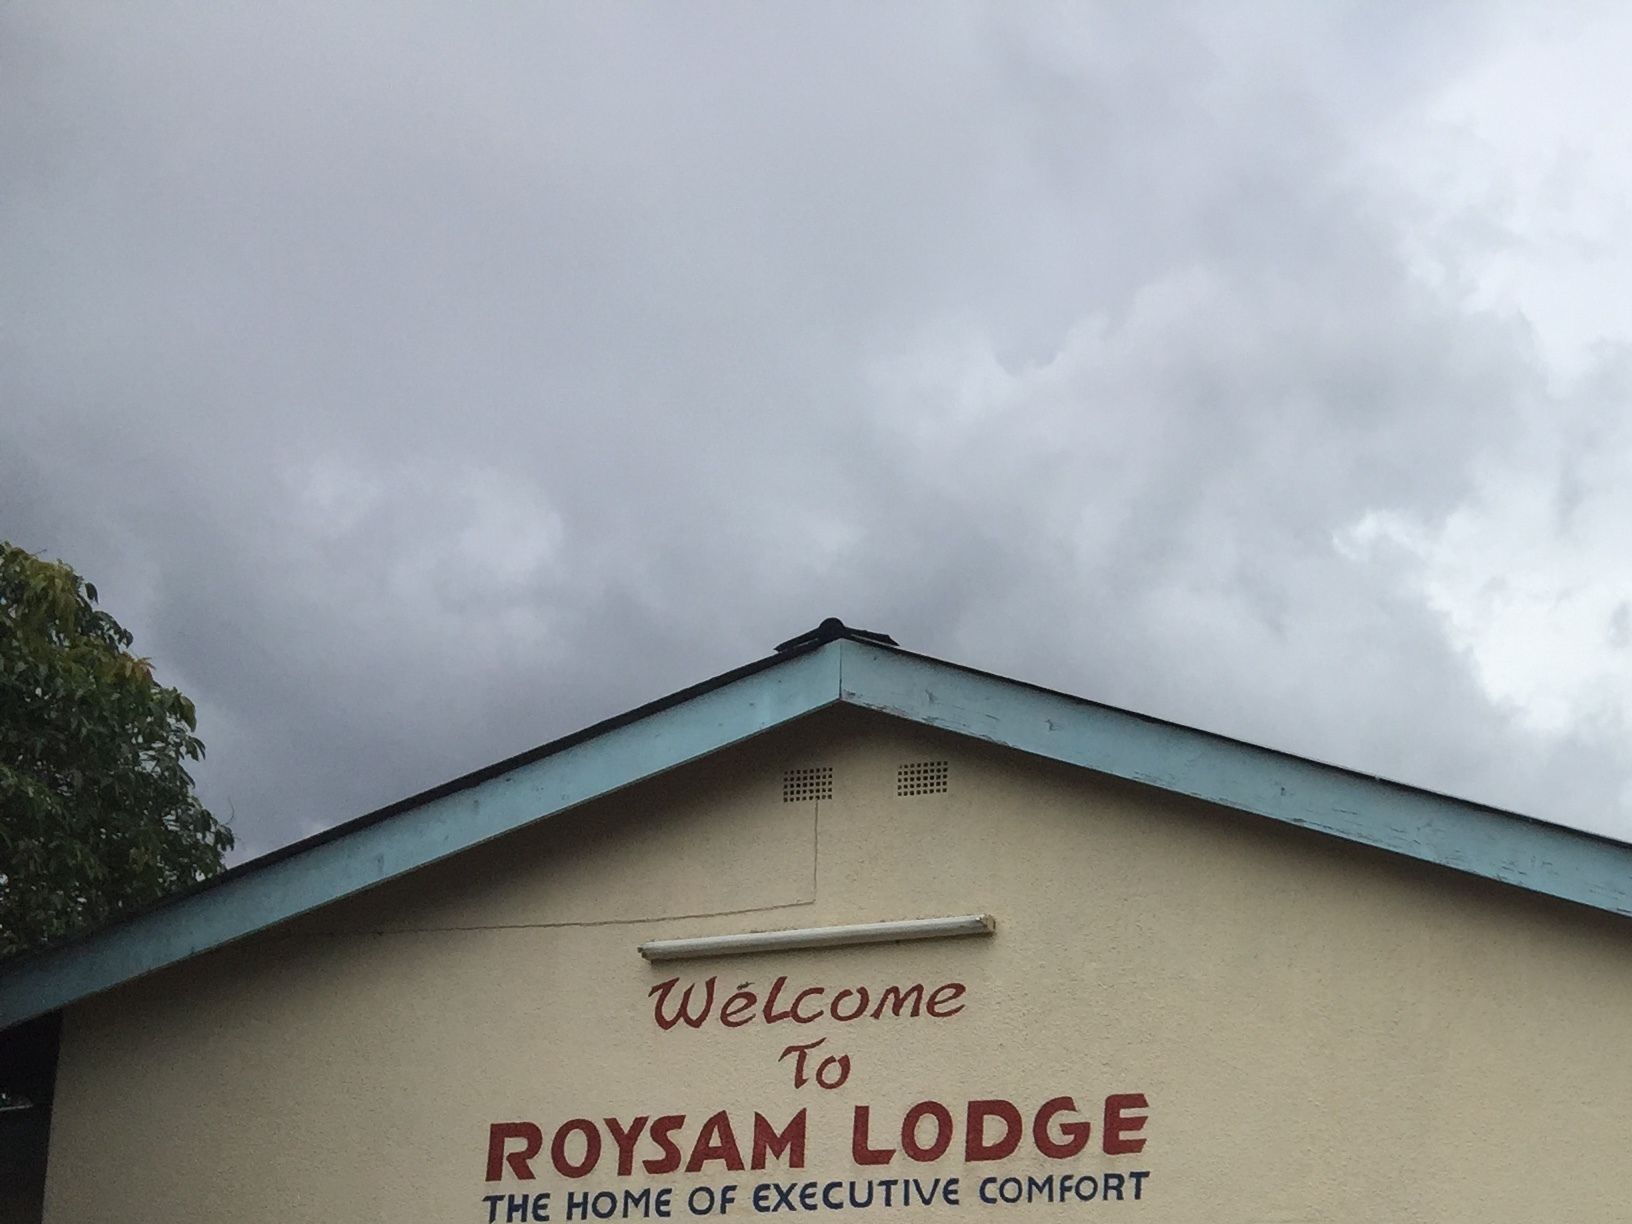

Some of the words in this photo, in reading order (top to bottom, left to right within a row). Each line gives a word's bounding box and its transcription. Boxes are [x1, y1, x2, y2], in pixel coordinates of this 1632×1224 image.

[778, 1037, 852, 1090] To
[485, 1107, 808, 1182] ROYSAM
[852, 1093, 1150, 1166] LODGE
[482, 1191, 551, 1224] THE
[566, 1187, 673, 1221] HOME
[688, 1184, 738, 1216] OF
[752, 1177, 960, 1213] EXECUTIVE
[979, 1171, 1152, 1205] COMFORT
